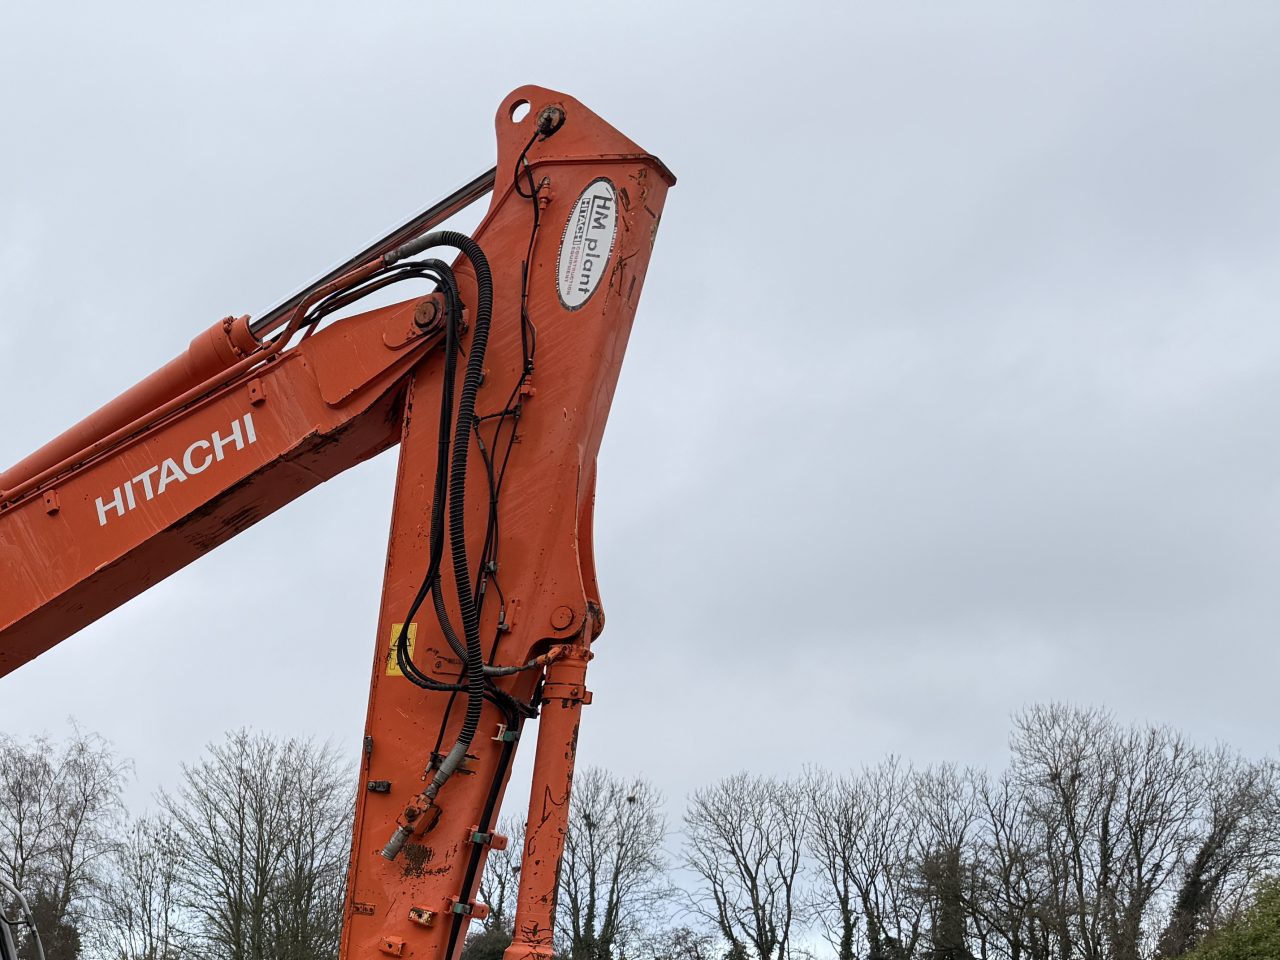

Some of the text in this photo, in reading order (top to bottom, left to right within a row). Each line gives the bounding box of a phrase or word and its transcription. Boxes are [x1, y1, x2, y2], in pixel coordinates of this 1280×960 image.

[573, 197, 591, 245] HITACHI
[578, 195, 613, 295] HM plant
[564, 246, 576, 283] EQUIPMENT
[566, 246, 581, 296] CONSTRUCTION
[95, 412, 257, 527] HITACHI
